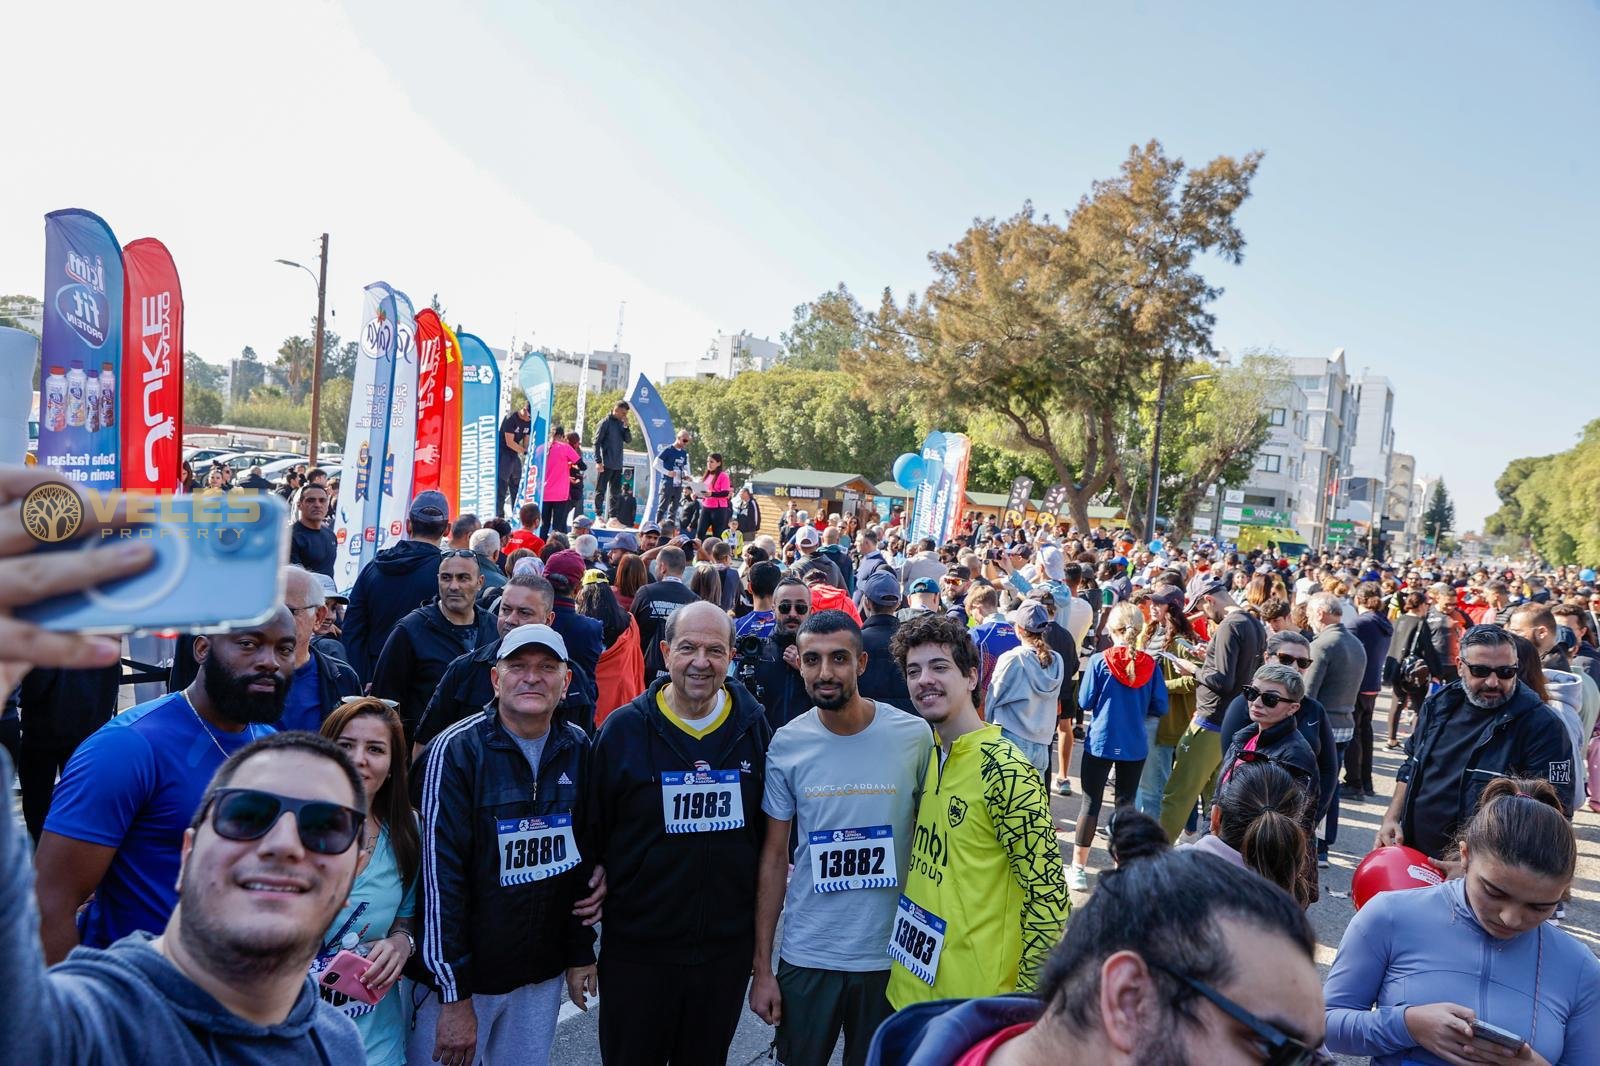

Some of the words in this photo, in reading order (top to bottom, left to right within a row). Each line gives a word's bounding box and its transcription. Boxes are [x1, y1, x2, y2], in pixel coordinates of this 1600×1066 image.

[774, 487, 789, 497] BK
[672, 791, 732, 820] 11983
[505, 834, 567, 871] 13880
[819, 846, 886, 879] 13882
[908, 853, 943, 888] group
[894, 916, 937, 967] 13883
